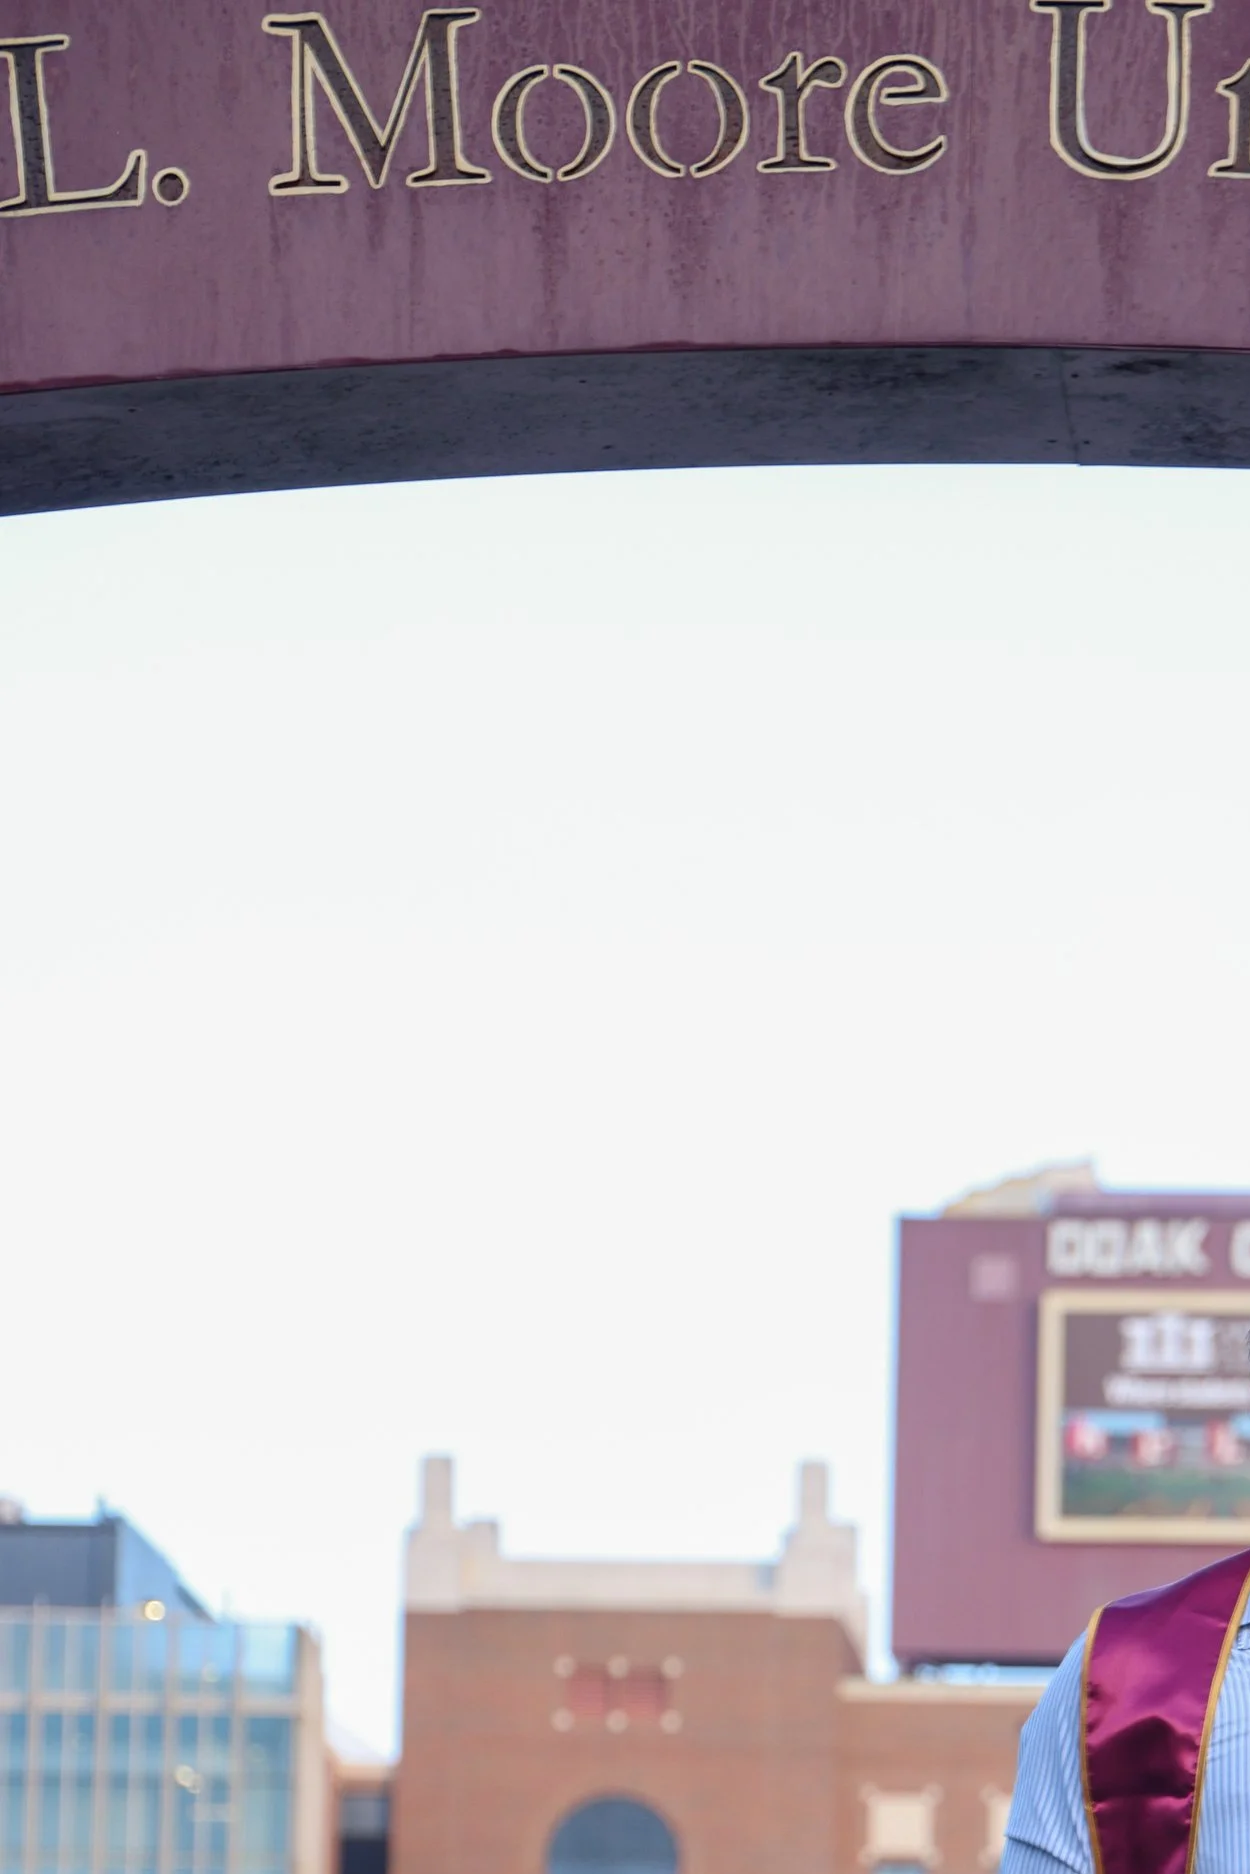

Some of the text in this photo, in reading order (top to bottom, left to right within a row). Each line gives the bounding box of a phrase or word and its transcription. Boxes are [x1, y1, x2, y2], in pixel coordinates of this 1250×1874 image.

[0, 34, 190, 218] L.
[261, 8, 948, 196] Moore
[1047, 1219, 1211, 1277] DOAK
